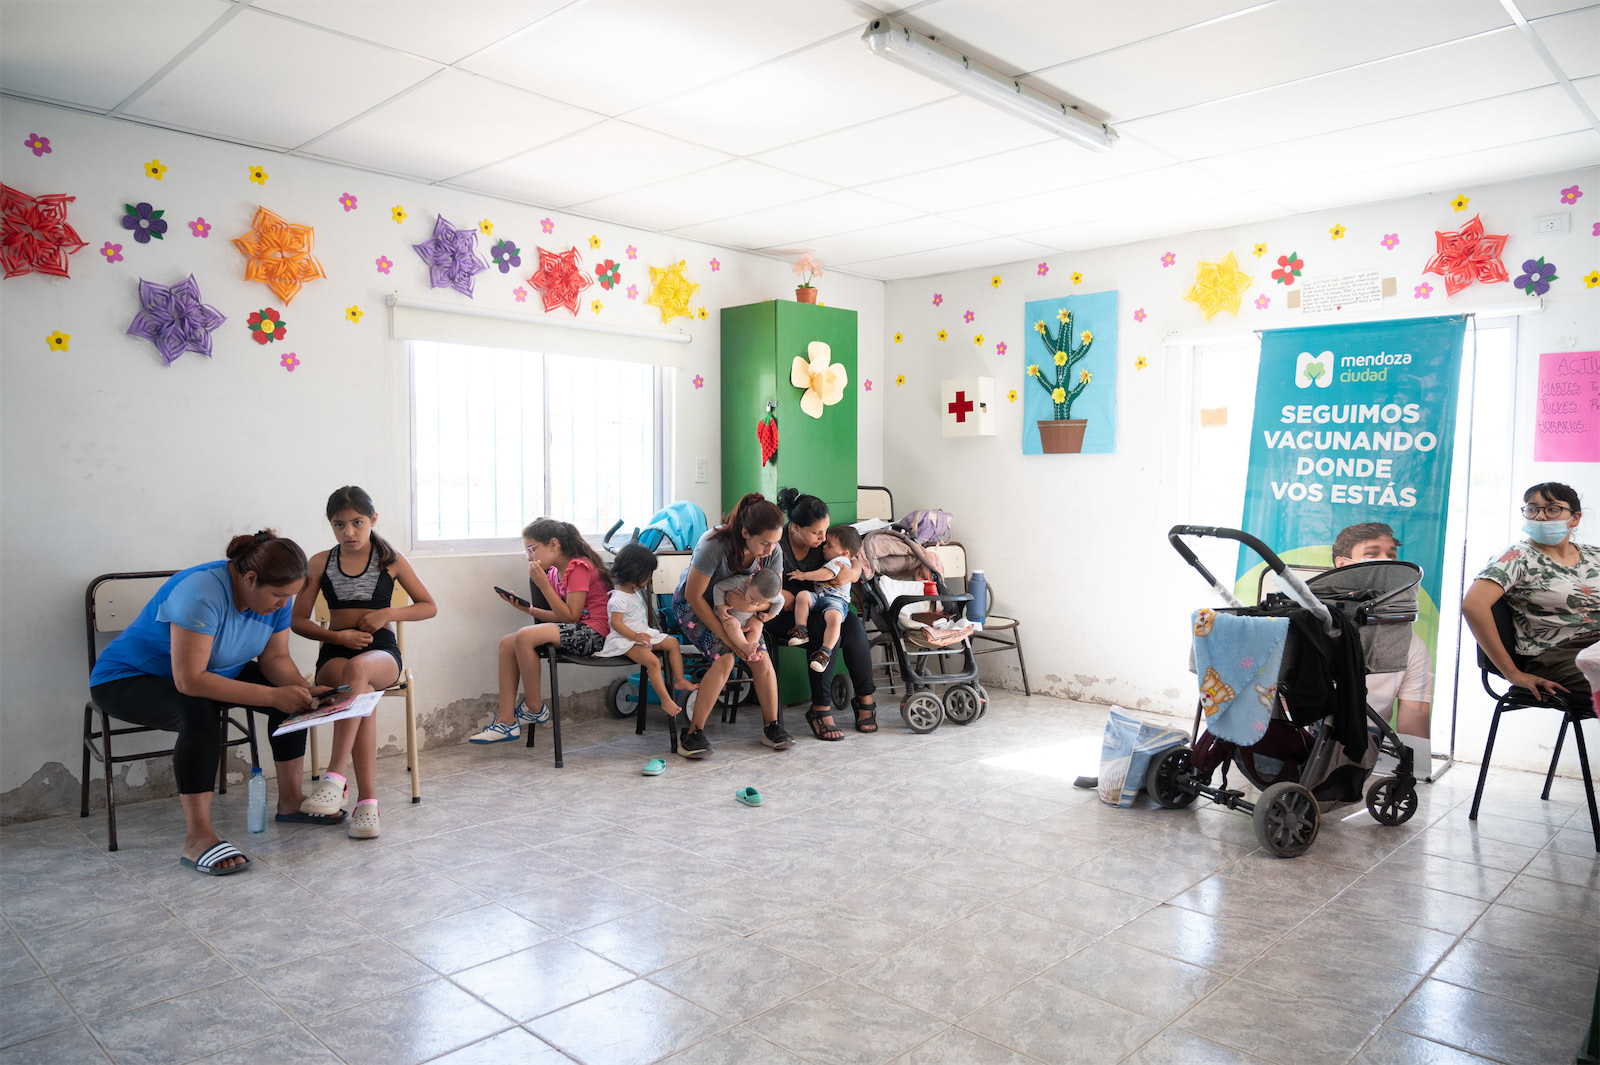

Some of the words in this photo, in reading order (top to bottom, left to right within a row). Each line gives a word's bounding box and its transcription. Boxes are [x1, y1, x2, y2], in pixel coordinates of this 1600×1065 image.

[1341, 351, 1412, 367] mendoza
[1340, 367, 1388, 383] ciudad
[1280, 403, 1420, 424] SEGUIMOS
[1264, 430, 1437, 452] VACUNANDO
[1297, 457, 1393, 479] DONDE
[1271, 481, 1324, 501] VOS
[1331, 482, 1417, 507] ESTÁS
